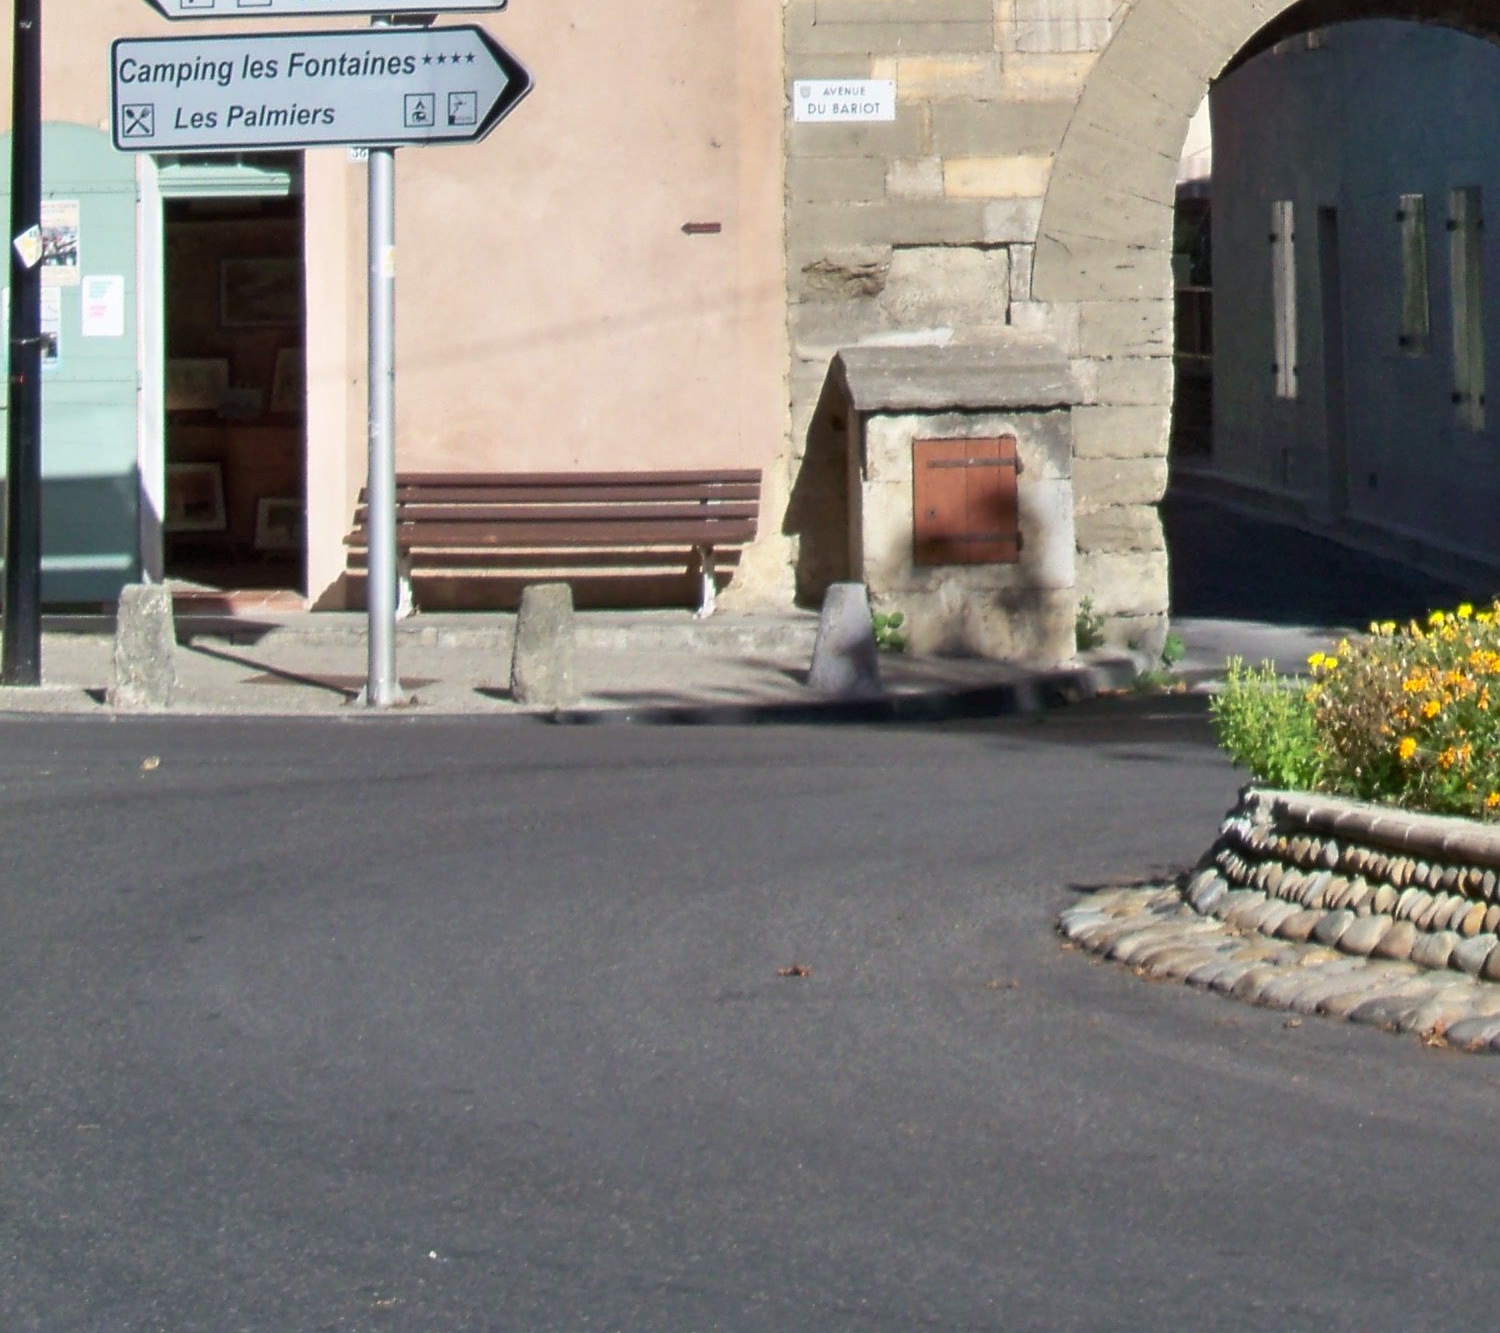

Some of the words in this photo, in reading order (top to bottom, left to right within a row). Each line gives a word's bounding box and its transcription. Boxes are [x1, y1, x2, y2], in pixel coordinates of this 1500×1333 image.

[119, 57, 234, 87] Camping
[242, 54, 279, 79] les
[287, 50, 416, 78] Fontaines
[823, 87, 866, 96] AVENUE
[174, 107, 218, 129] Les
[226, 103, 336, 128] Palmiers
[807, 104, 826, 114] DU
[832, 103, 880, 114] BARIOT
